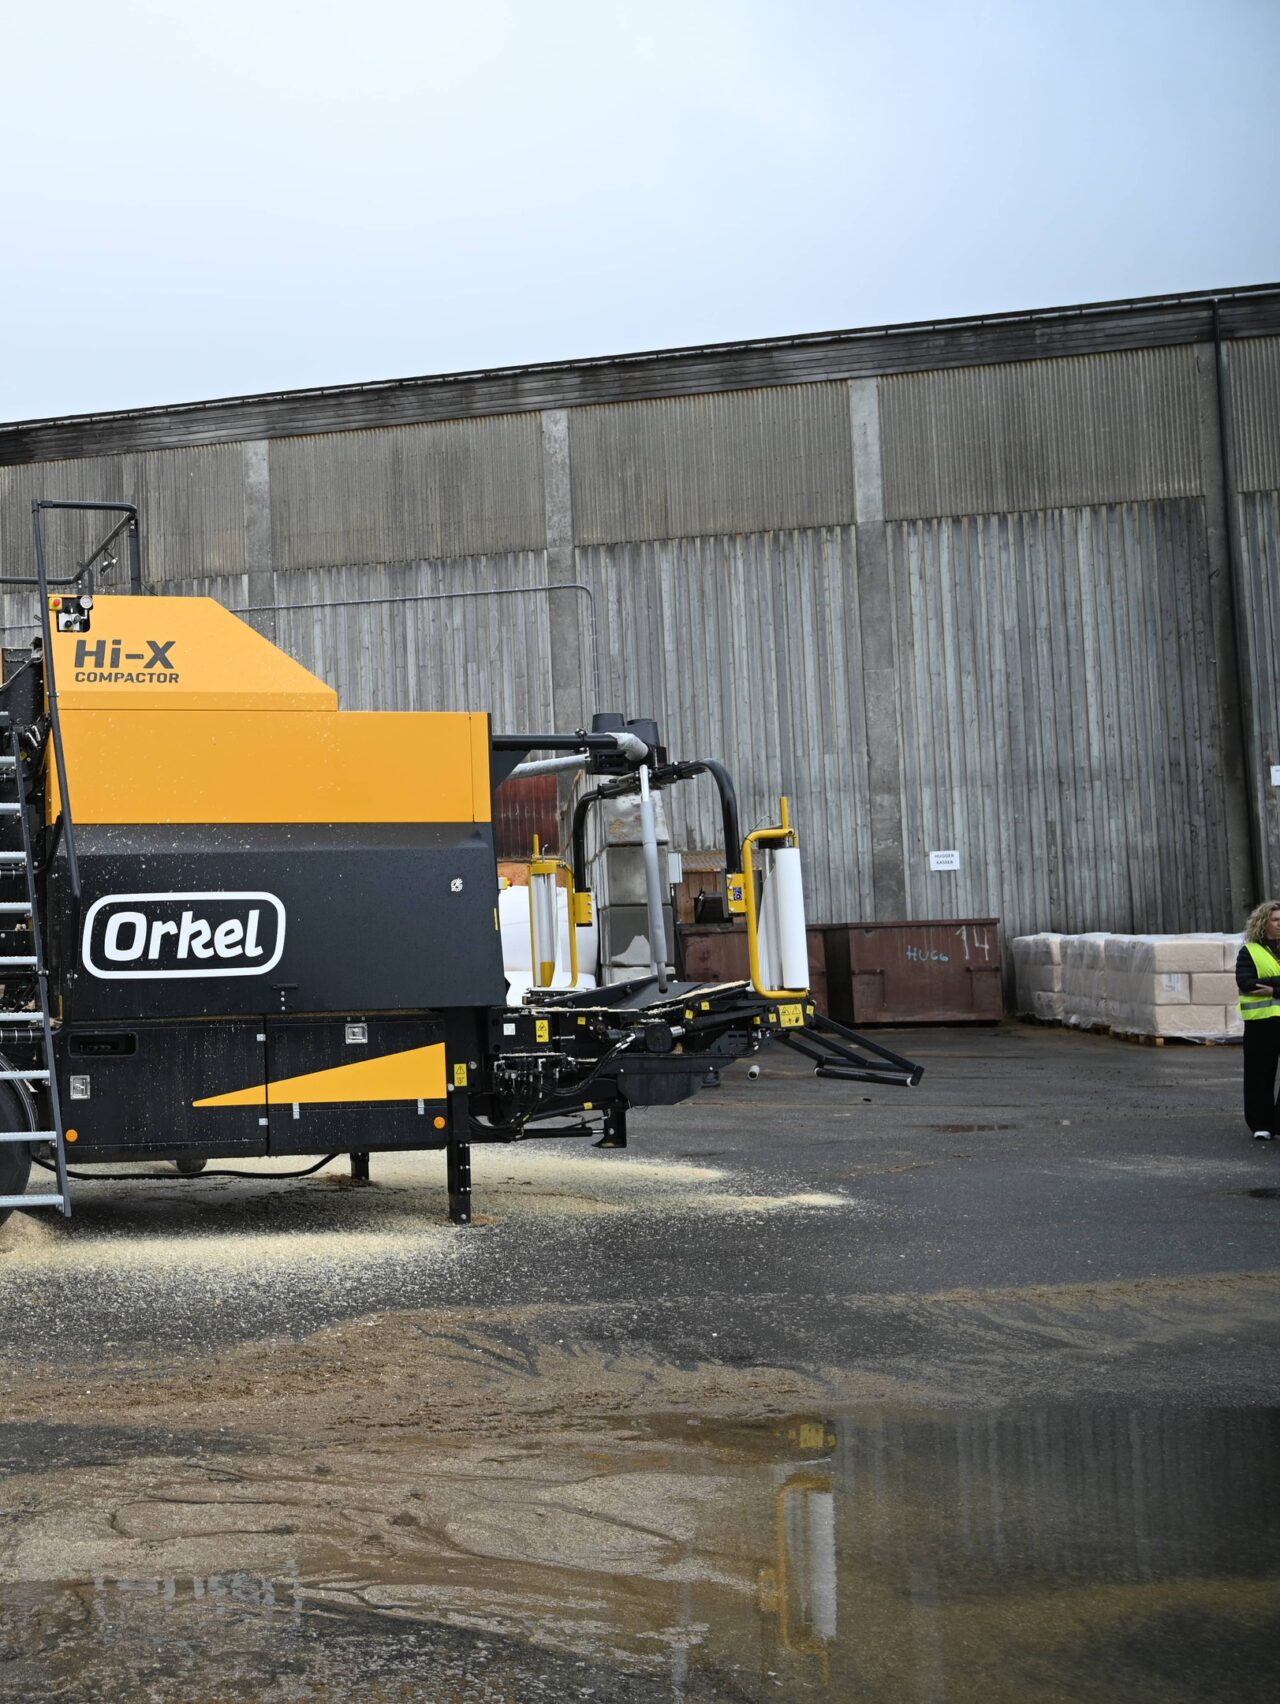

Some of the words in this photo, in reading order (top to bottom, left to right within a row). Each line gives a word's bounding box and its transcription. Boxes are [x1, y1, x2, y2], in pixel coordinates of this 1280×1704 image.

[74, 639, 177, 669] Hi-X
[74, 671, 180, 684] COMPACTOR
[104, 909, 264, 962] Orkel
[955, 925, 990, 961] 14
